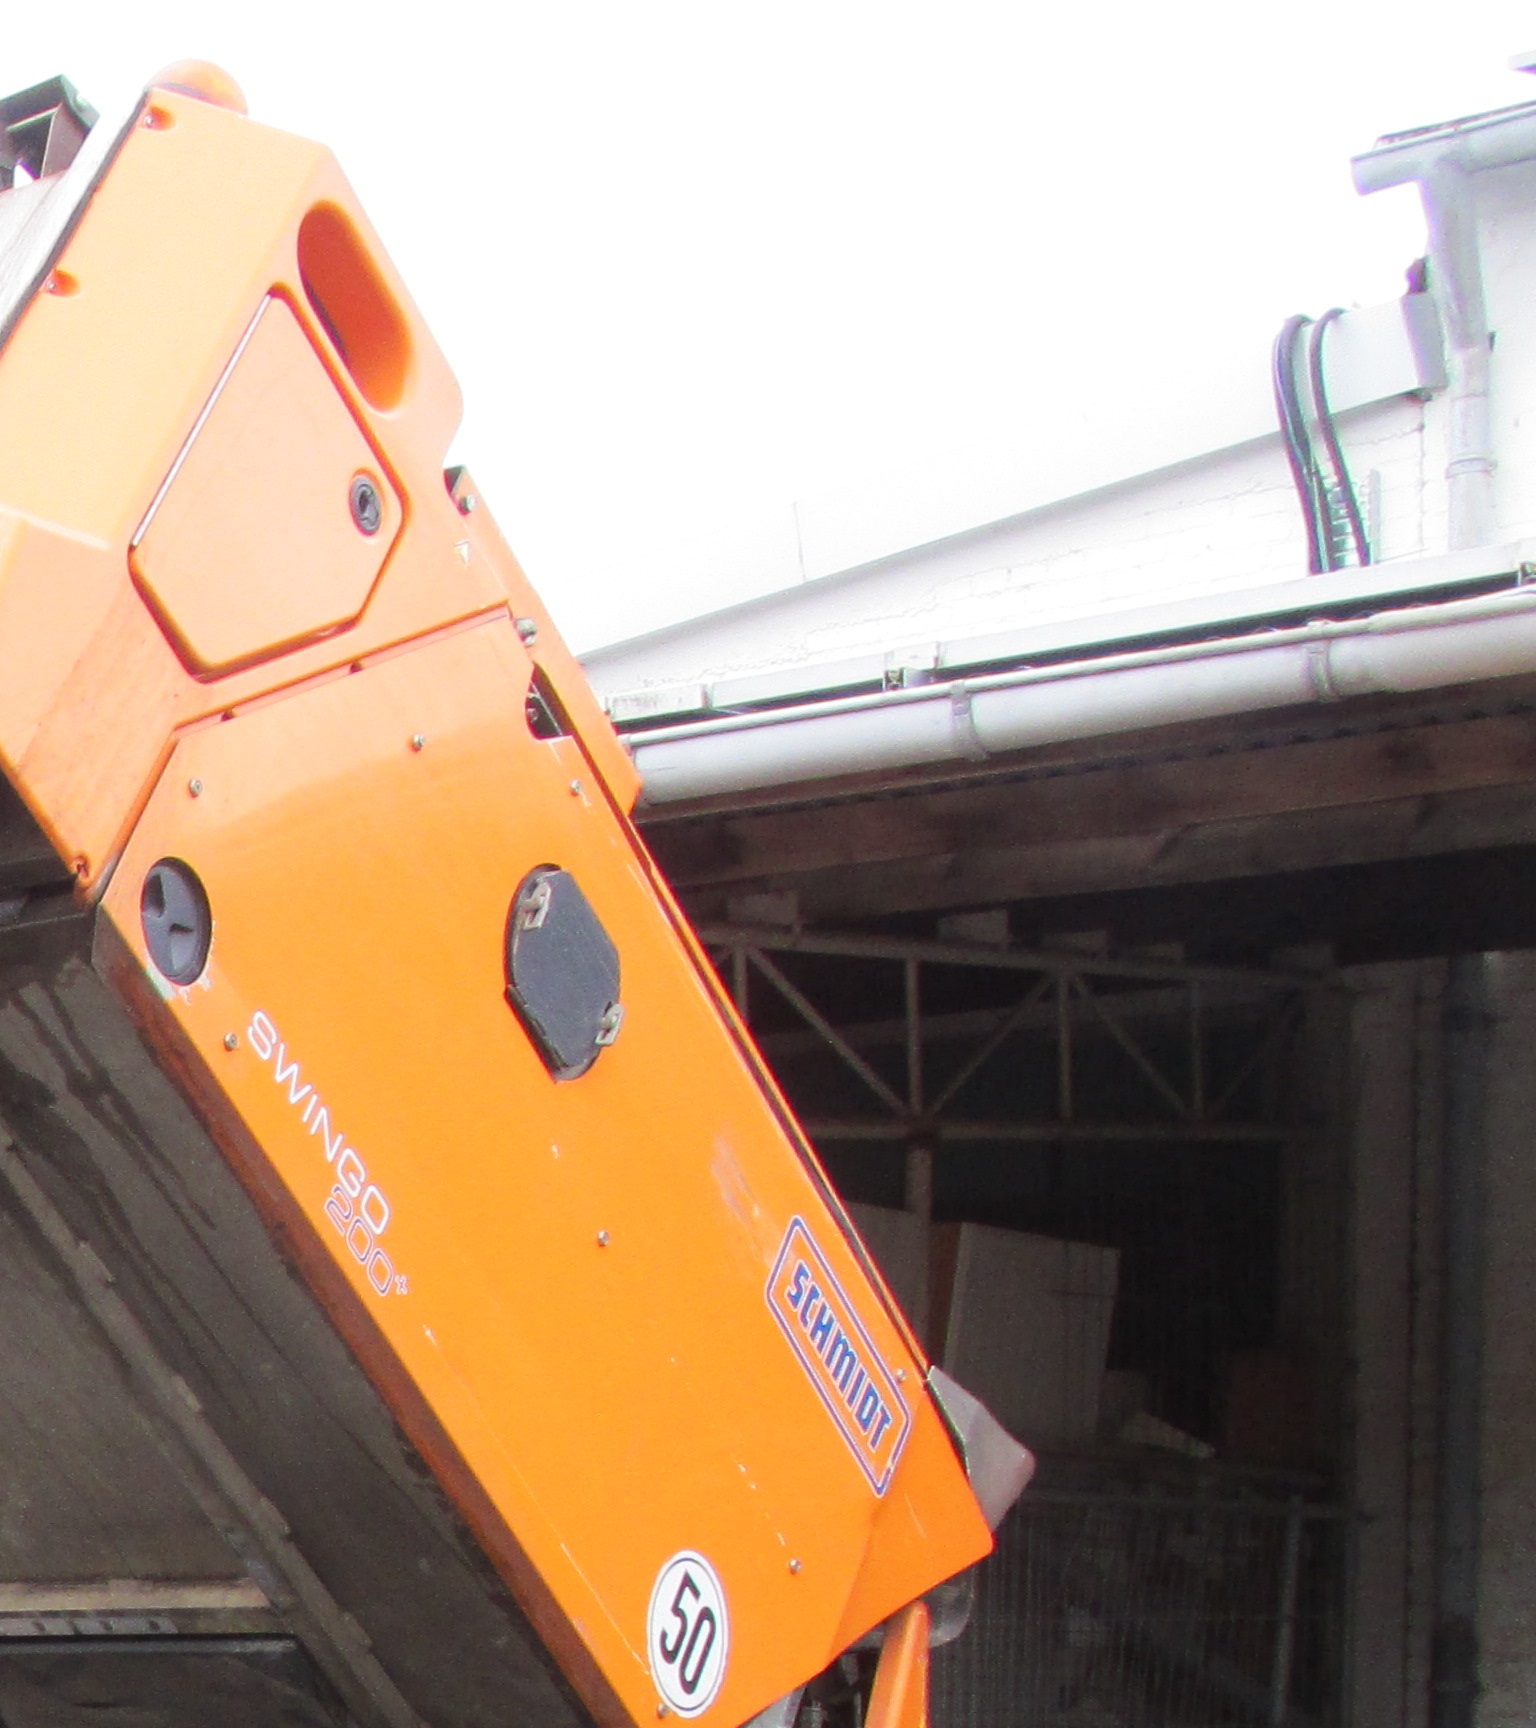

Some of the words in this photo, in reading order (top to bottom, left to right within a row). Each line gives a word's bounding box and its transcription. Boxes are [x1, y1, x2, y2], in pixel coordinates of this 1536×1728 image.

[247, 1009, 391, 1235] SWINGO
[784, 1260, 894, 1453] SCHMIDT
[660, 1572, 717, 1695] 50
